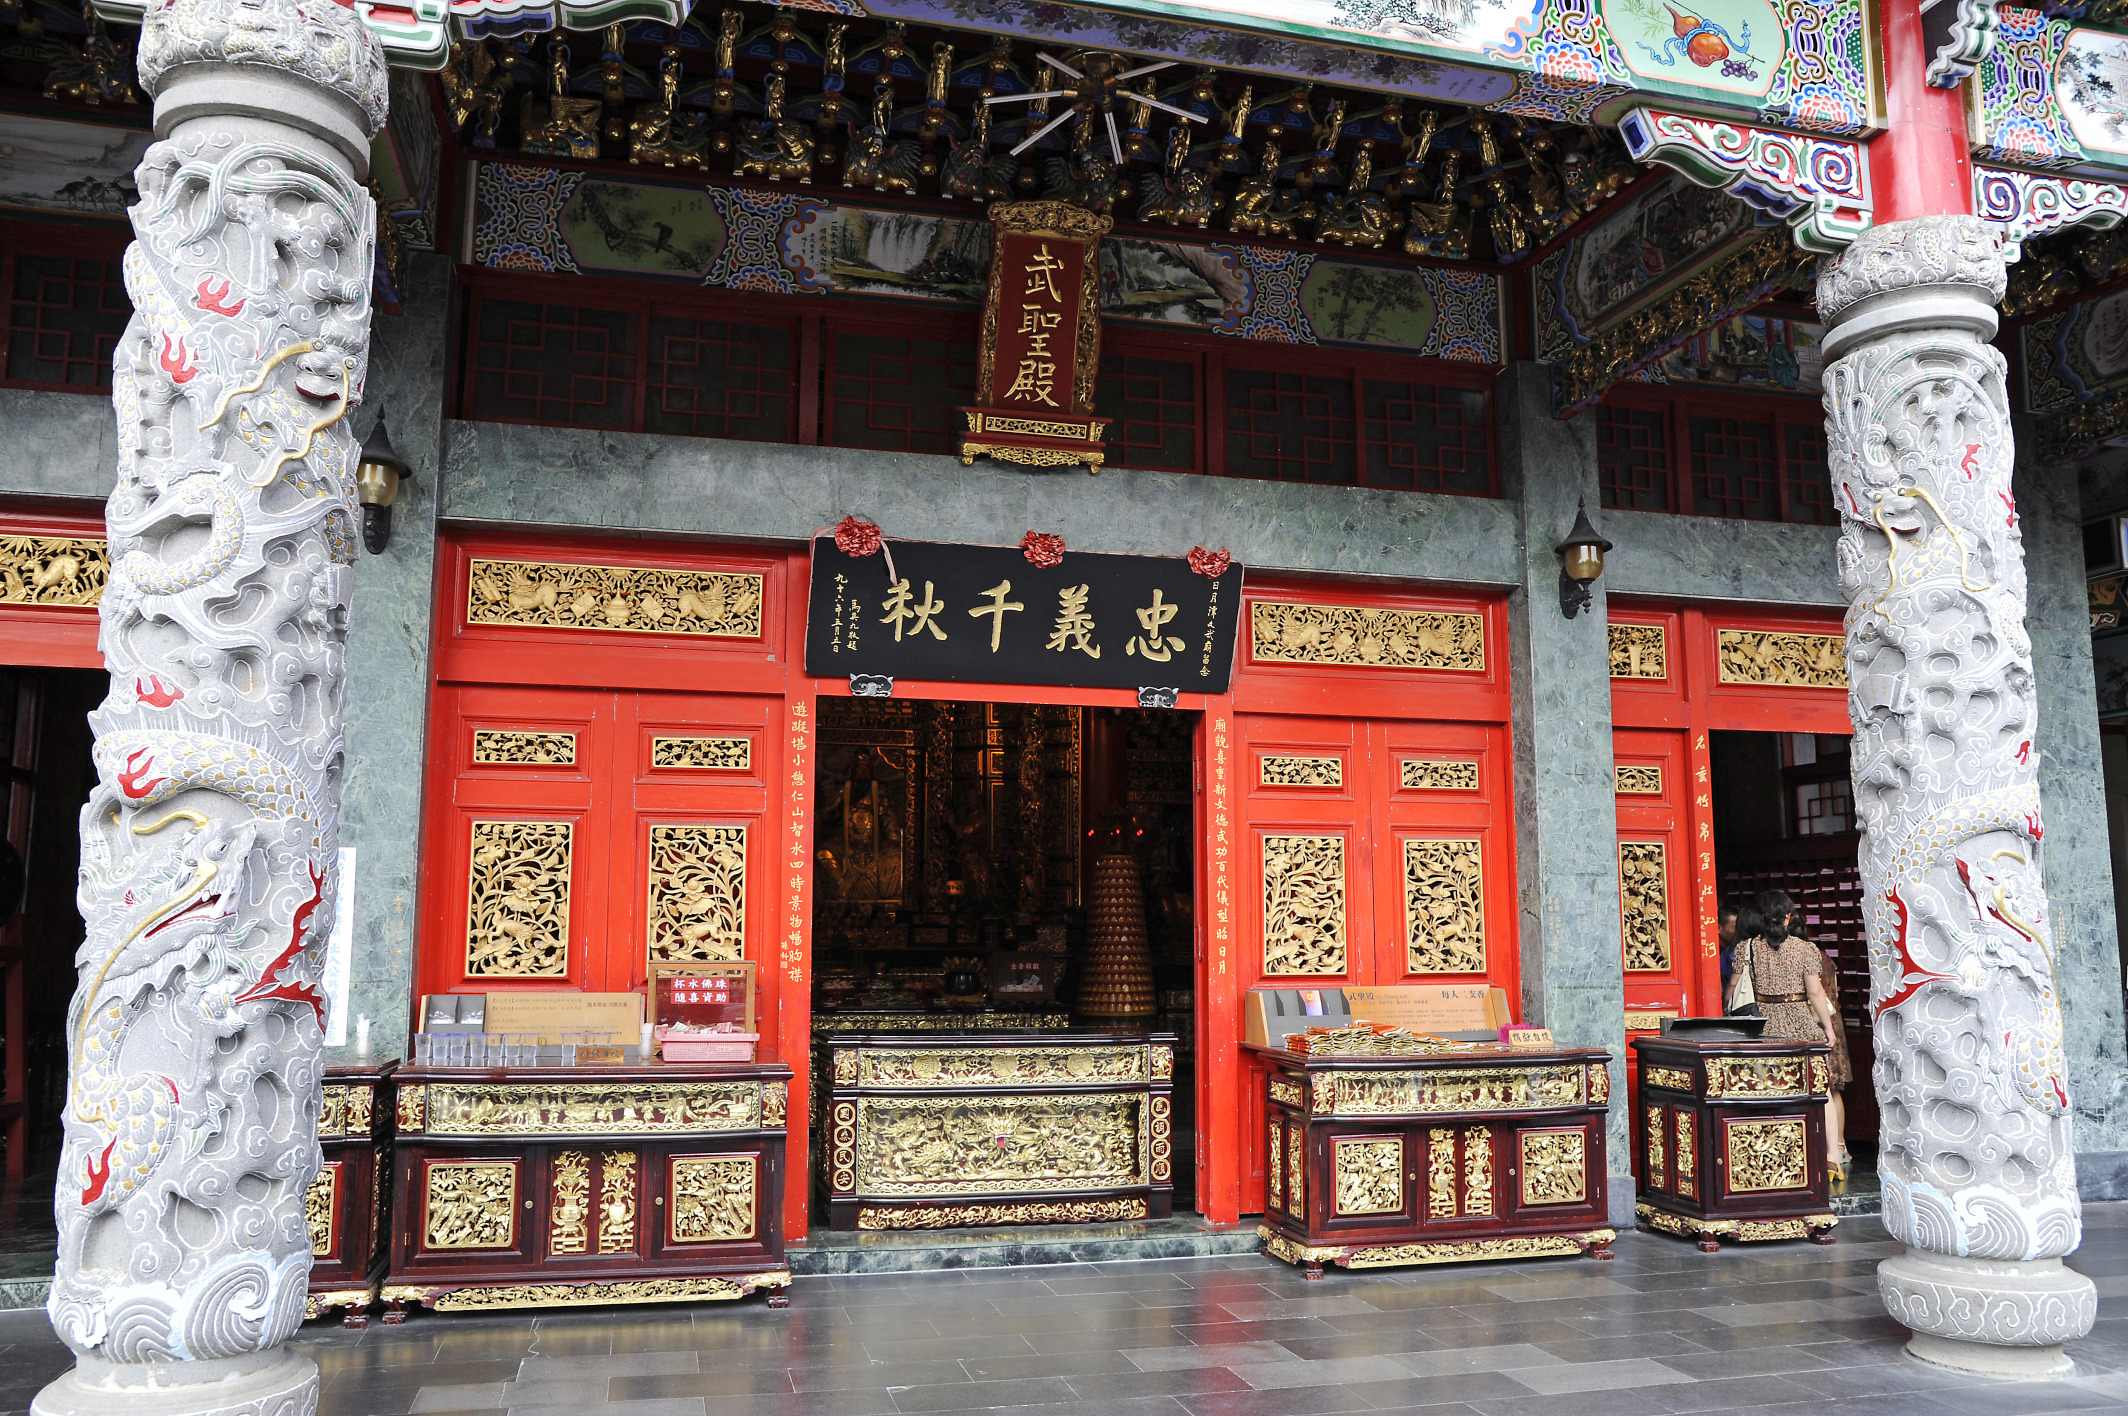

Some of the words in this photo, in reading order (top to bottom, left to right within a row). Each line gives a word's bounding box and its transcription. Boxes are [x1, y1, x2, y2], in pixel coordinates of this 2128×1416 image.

[1004, 243, 1064, 407] 武聖殿
[880, 578, 1186, 663] 忠義千秋
[673, 978, 728, 990] 杯水佛珠
[674, 991, 728, 1003] 隨喜資助
